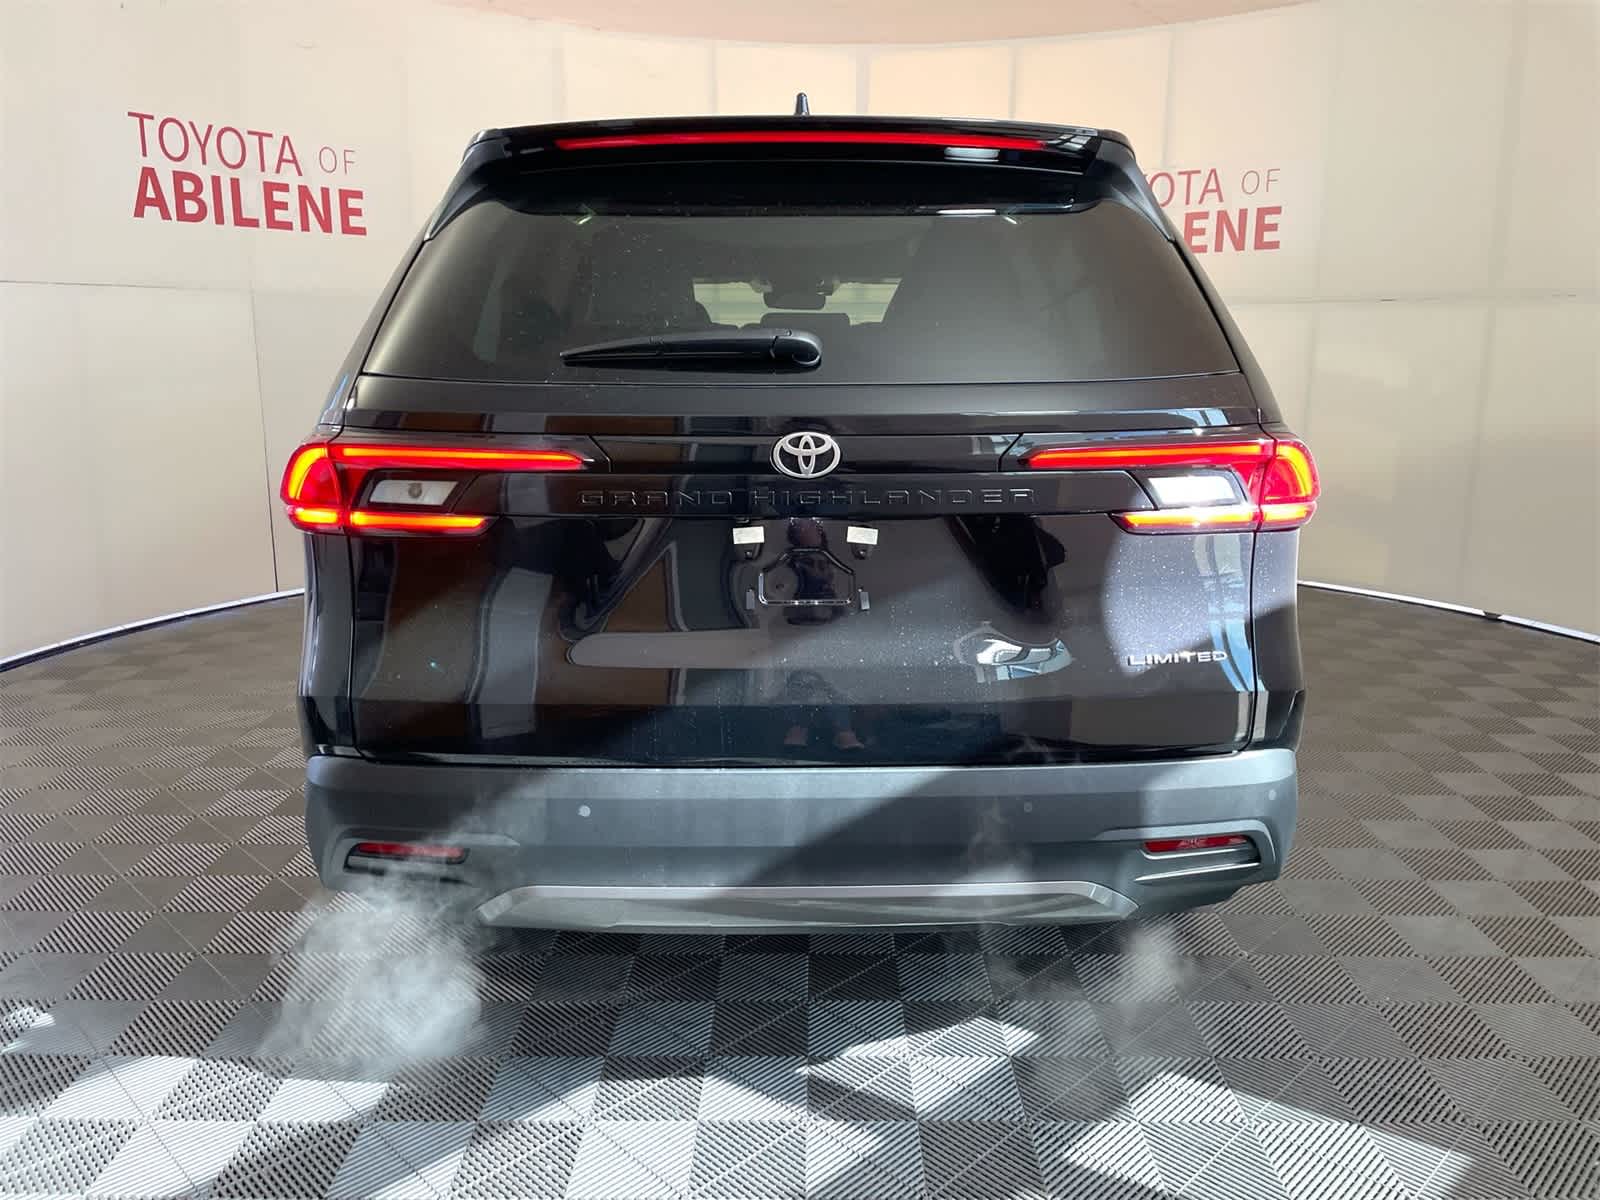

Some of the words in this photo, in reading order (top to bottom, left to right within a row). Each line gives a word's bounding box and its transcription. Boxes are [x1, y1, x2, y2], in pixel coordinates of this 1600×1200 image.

[127, 111, 303, 177] TOYOTA
[318, 146, 356, 174] OF
[133, 166, 368, 236] ABILENE
[1147, 168, 1224, 207] OTA
[1241, 168, 1281, 195] OF
[578, 490, 734, 505] GRAND
[753, 488, 1036, 505] HIGHLANDER
[1127, 651, 1228, 666] LIMITED
